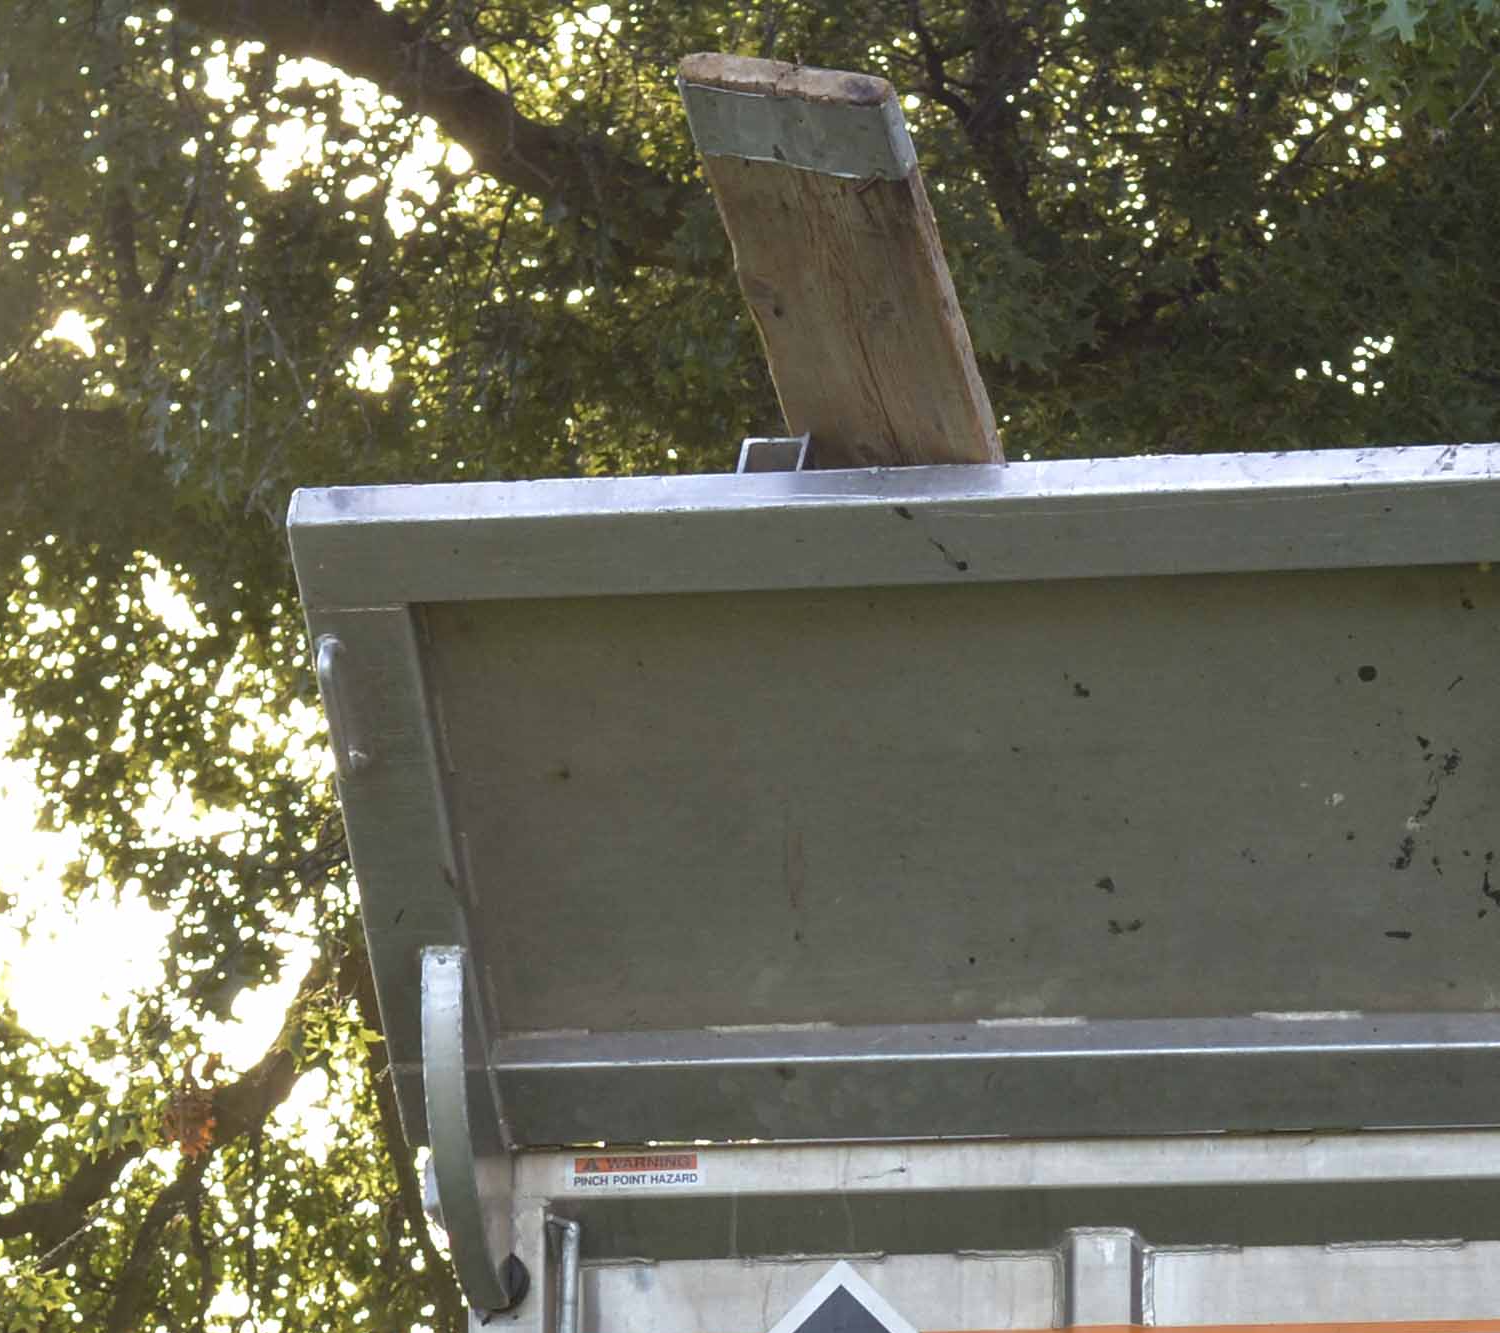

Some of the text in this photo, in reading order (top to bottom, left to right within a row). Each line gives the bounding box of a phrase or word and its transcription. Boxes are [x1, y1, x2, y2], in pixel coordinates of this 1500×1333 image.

[608, 1155, 691, 1169] WARNING
[574, 1173, 698, 1186] PINCH POINT HAZARD
